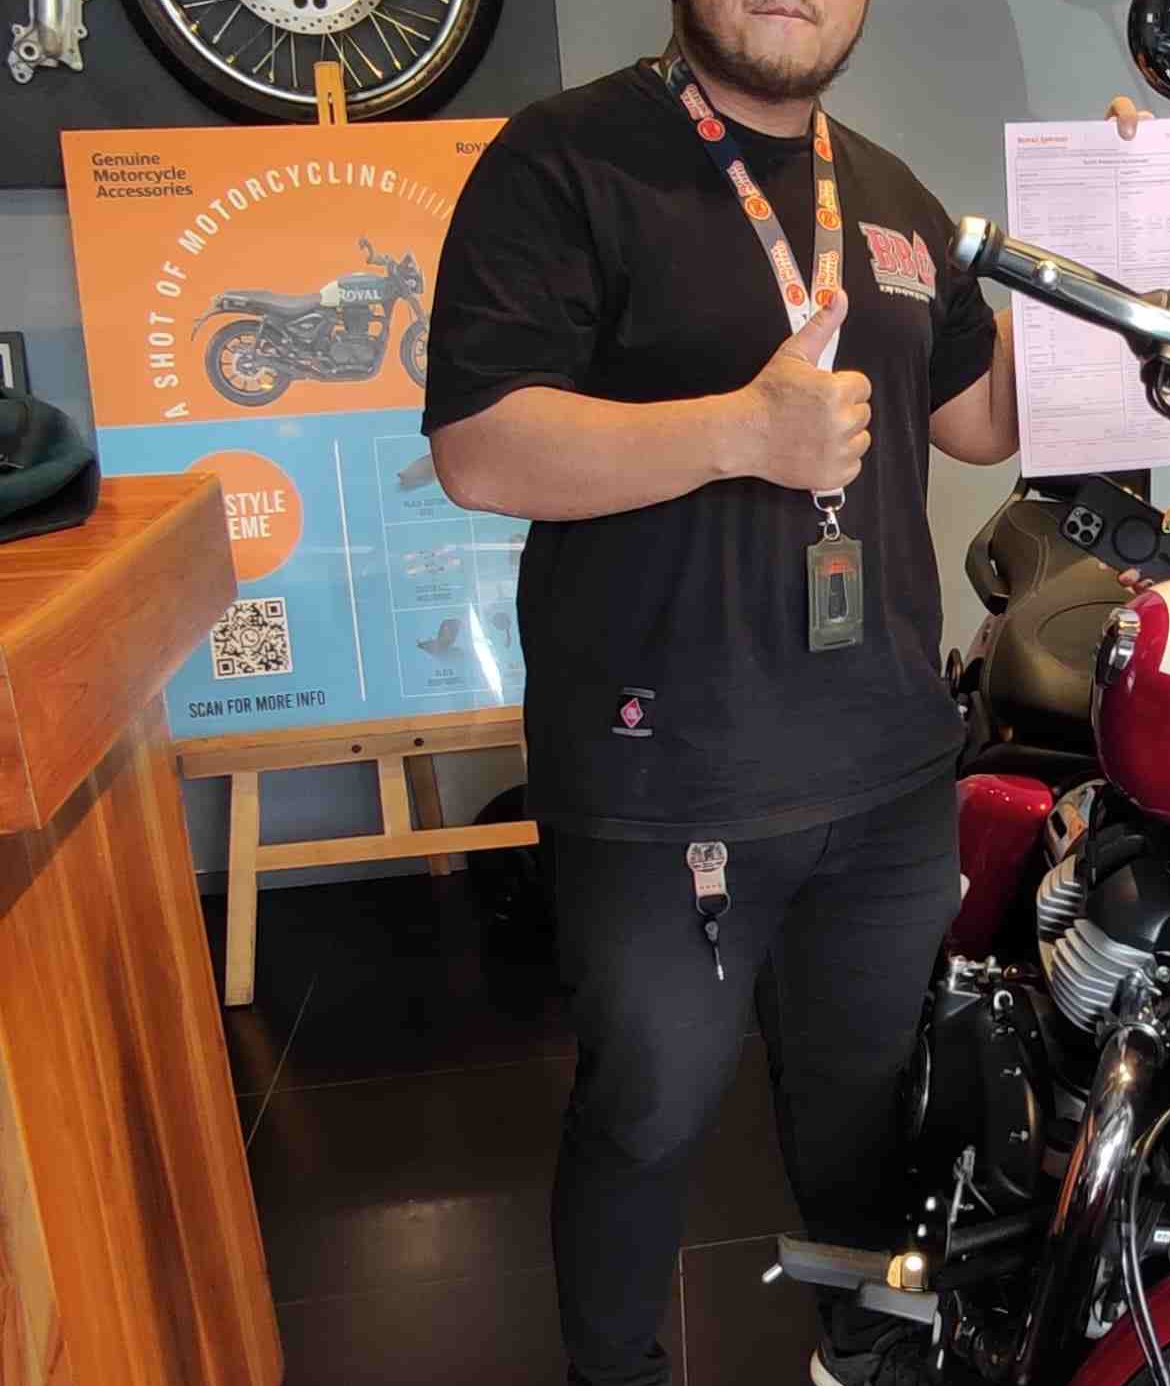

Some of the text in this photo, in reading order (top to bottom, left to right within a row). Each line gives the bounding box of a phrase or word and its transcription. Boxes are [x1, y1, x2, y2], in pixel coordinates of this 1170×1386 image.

[91, 152, 161, 166] Genuine
[93, 166, 187, 183] Motorcycle
[96, 182, 193, 198] Accessories
[148, 162, 398, 419] A SHOT OF MOTORCYCLING
[188, 690, 326, 718] SCAN FOR MORE INFO
